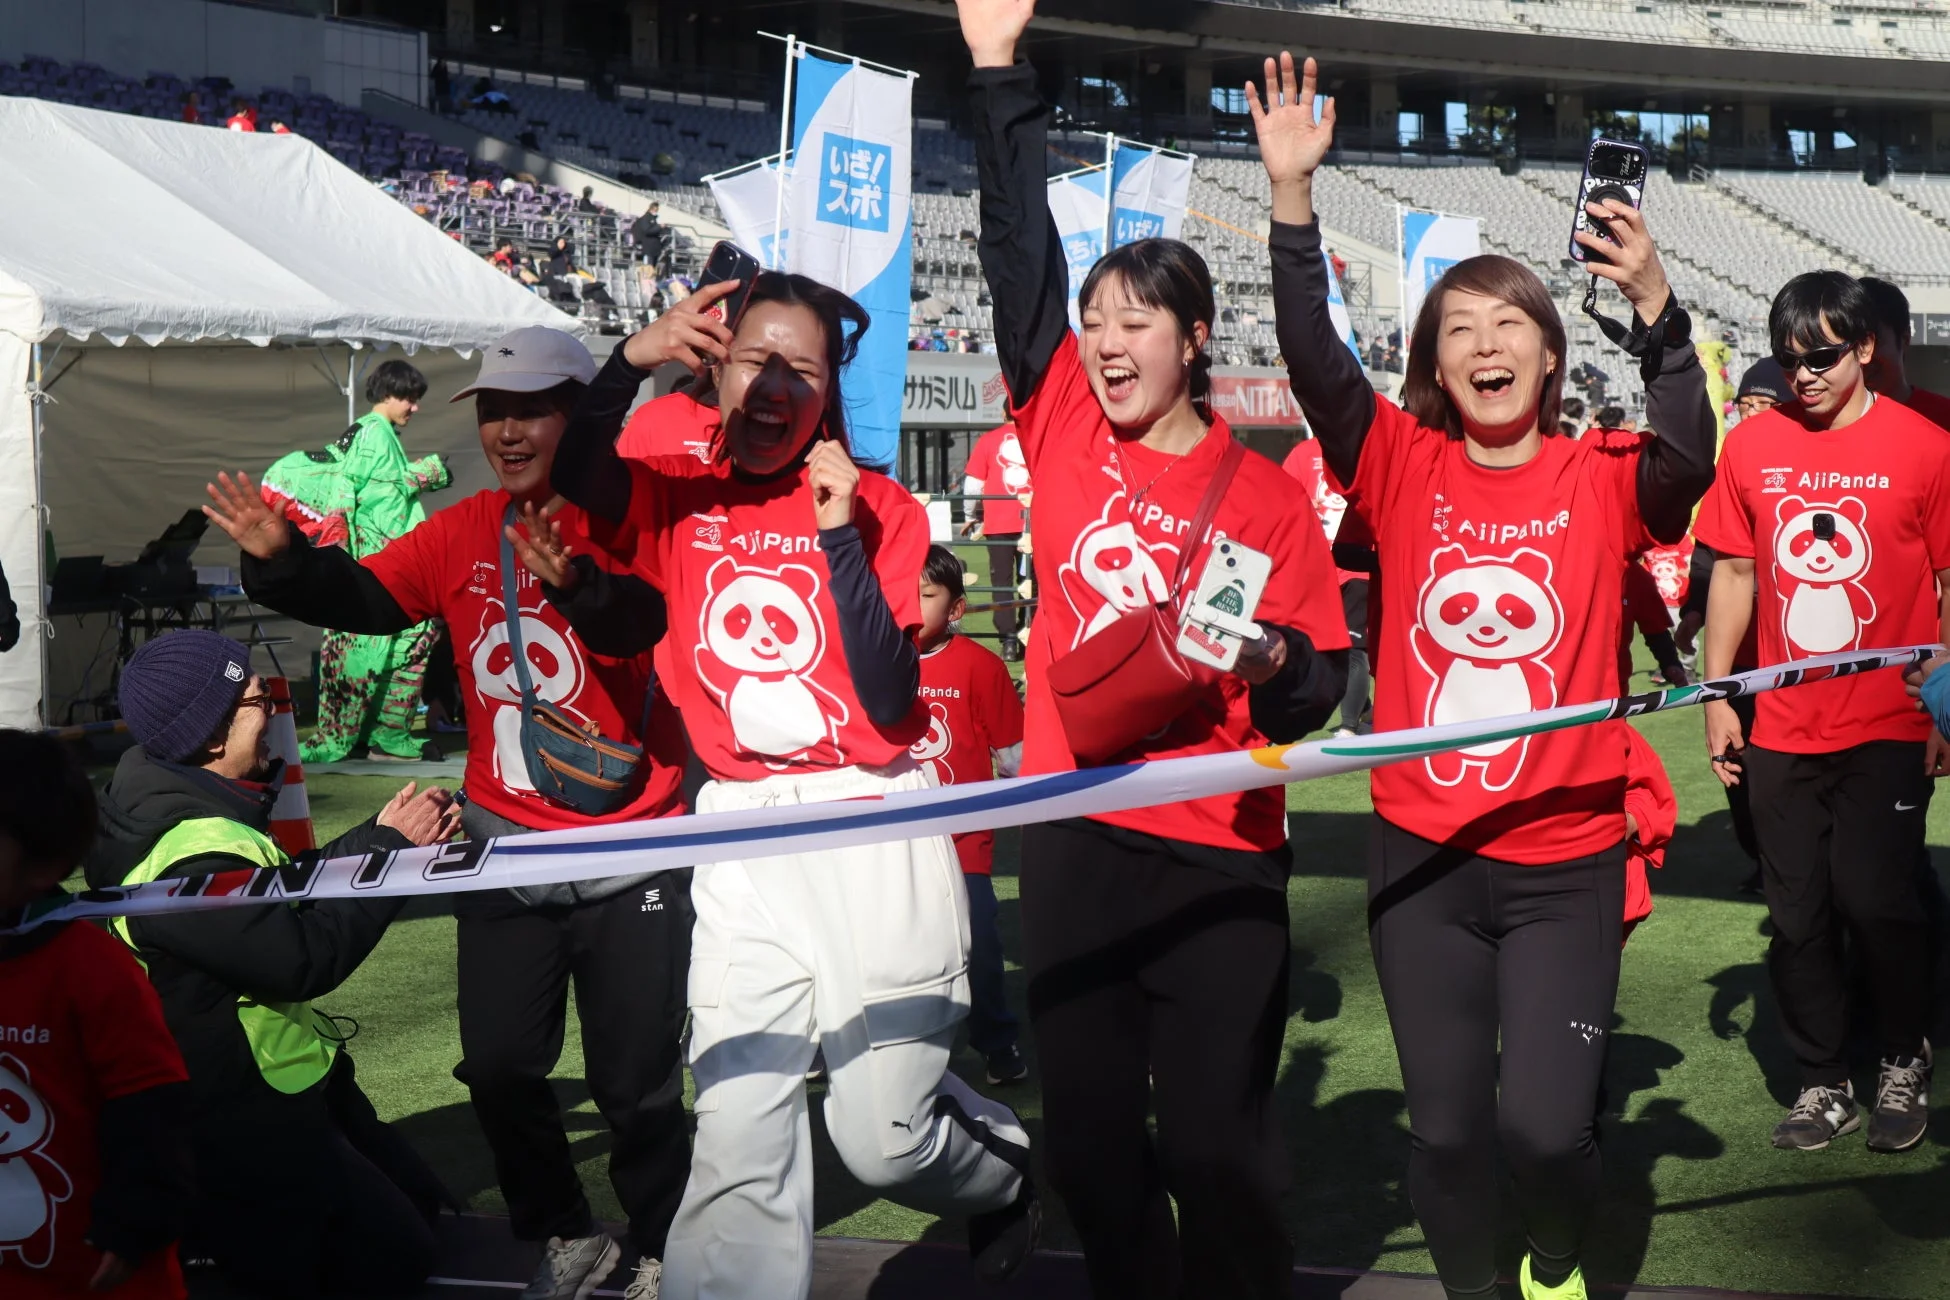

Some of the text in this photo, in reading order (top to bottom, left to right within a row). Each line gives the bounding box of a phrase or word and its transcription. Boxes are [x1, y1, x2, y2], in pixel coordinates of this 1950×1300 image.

[826, 179, 882, 220] スポ
[903, 375, 977, 410] サガミハム
[1798, 471, 1890, 491] AjiPanda
[730, 529, 822, 555] AjiPan
[1221, 595, 1238, 607] THE
[1227, 589, 1239, 599] BE
